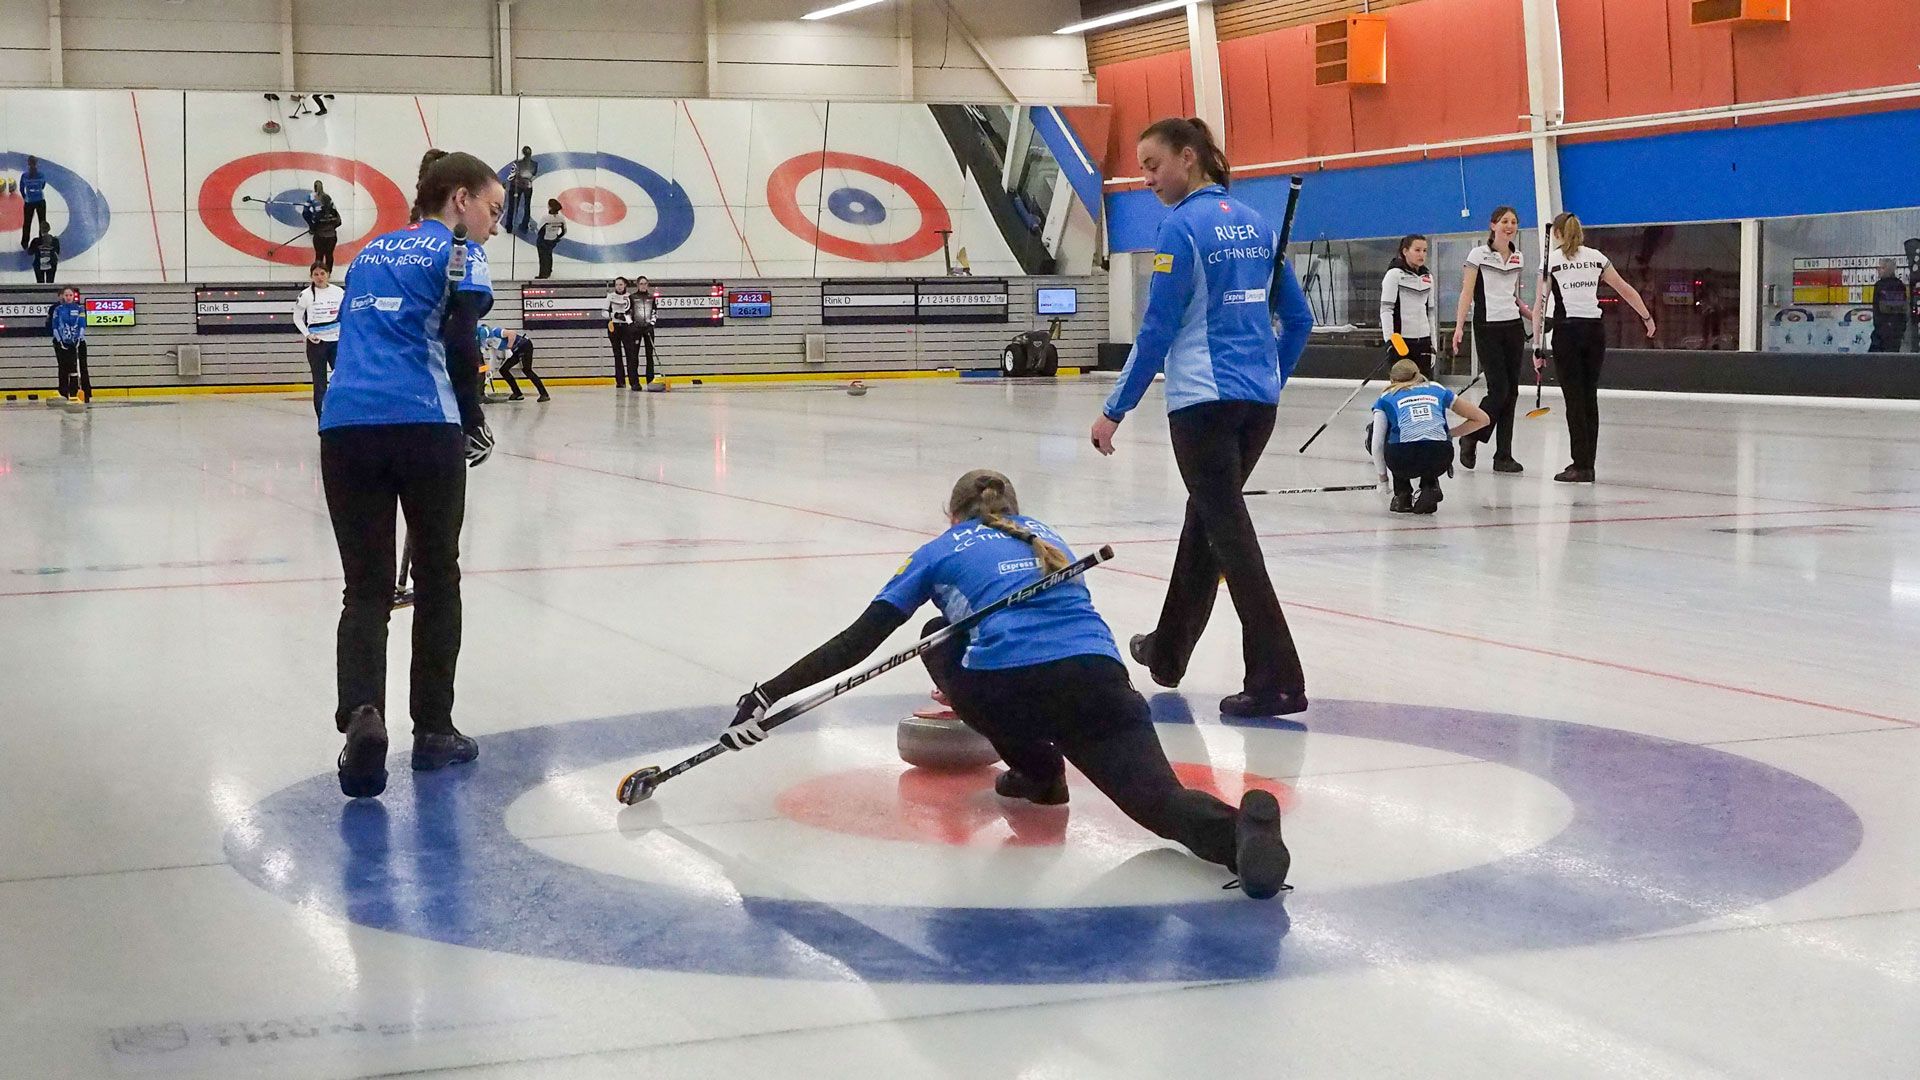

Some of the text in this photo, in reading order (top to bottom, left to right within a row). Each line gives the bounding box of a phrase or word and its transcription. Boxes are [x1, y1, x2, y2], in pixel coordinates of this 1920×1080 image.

[365, 236, 447, 252] AUCHLI
[395, 254, 433, 267] REGIO
[1208, 251, 1222, 264] CC
[1562, 262, 1596, 270] BADEN
[95, 302, 124, 310] 24:52
[199, 303, 230, 312] Rink B
[525, 300, 554, 308] Rink C
[96, 316, 124, 324] 25:47
[954, 538, 976, 552] CC
[1000, 561, 1034, 572] Express
[1008, 563, 1086, 607] Hardline
[834, 641, 931, 697] Hardline
